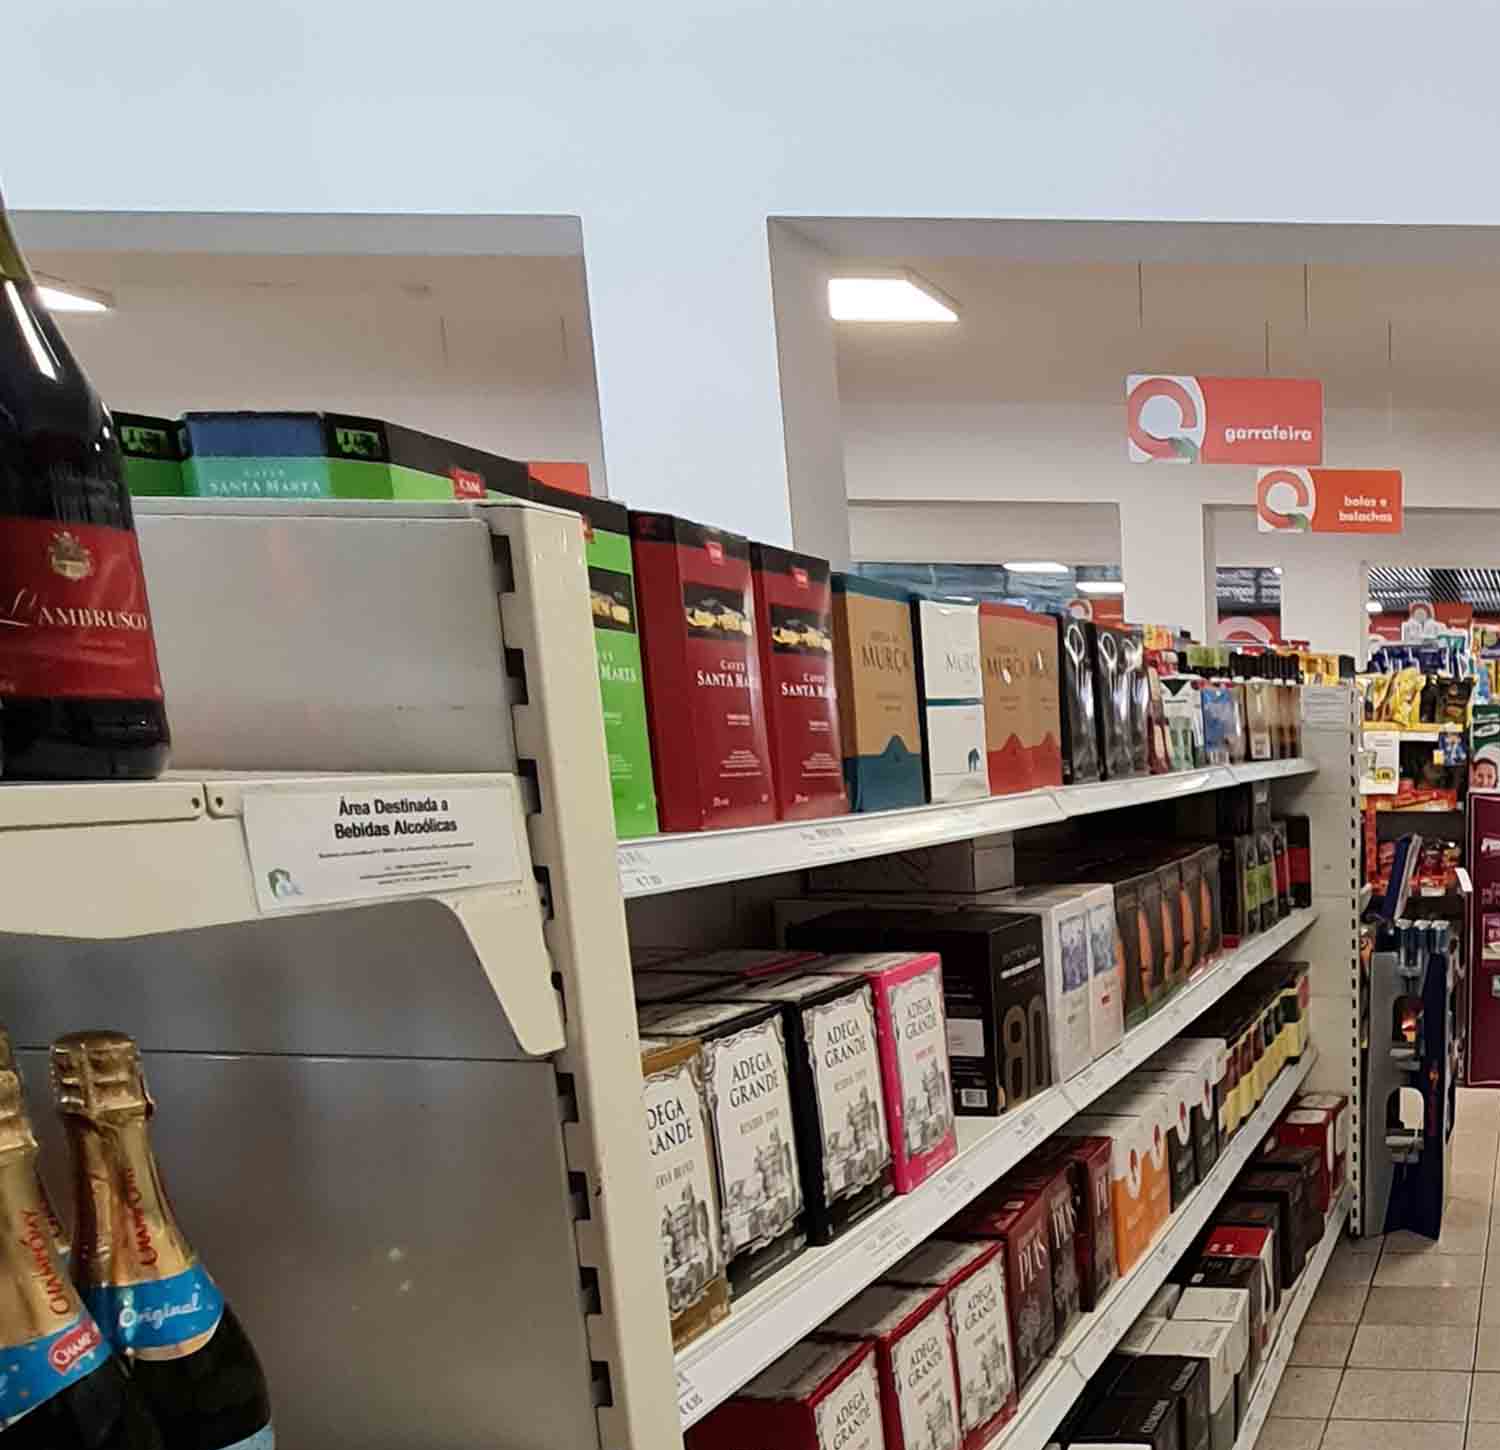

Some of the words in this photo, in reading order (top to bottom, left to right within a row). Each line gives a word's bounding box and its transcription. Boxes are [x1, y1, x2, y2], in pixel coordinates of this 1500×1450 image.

[1224, 424, 1312, 443] garrafeira
[207, 479, 260, 494] SANTA
[264, 479, 321, 494] MARTA
[1338, 509, 1393, 523] bolachas
[697, 668, 734, 688] SANTA
[781, 681, 816, 698] SANTA
[339, 796, 370, 817] Área
[374, 797, 438, 815] Destinada
[441, 798, 449, 812] a
[334, 821, 390, 840] Bebidas
[394, 818, 458, 837] Alcoólicas
[827, 1018, 862, 1046] ADEGA
[824, 1034, 868, 1069] GRANDE
[732, 1051, 774, 1084] ADEGA
[729, 1069, 781, 1108] GRANDE
[118, 1291, 202, 1331] Original
[910, 1335, 940, 1368] ADEGA
[835, 1390, 867, 1427] ADEGA
